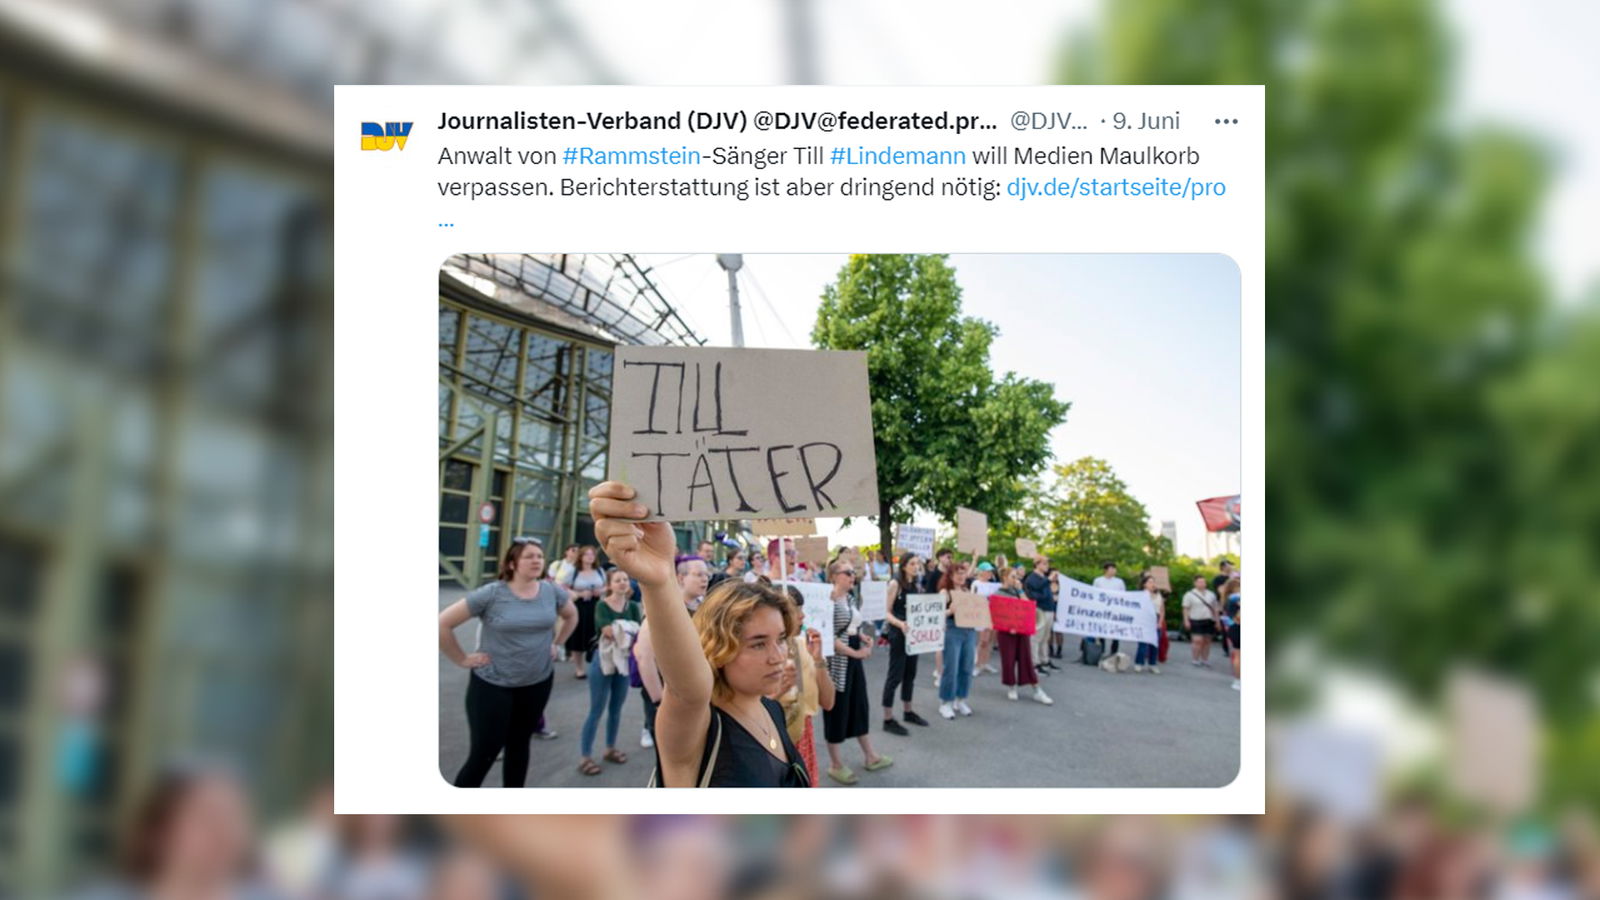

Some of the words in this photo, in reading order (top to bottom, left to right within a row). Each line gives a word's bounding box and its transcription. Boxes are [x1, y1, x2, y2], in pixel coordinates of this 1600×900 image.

[623, 360, 749, 436] TILL
[631, 436, 843, 517] TÄTER
[1070, 588, 1094, 600] Das
[1098, 592, 1142, 608] System
